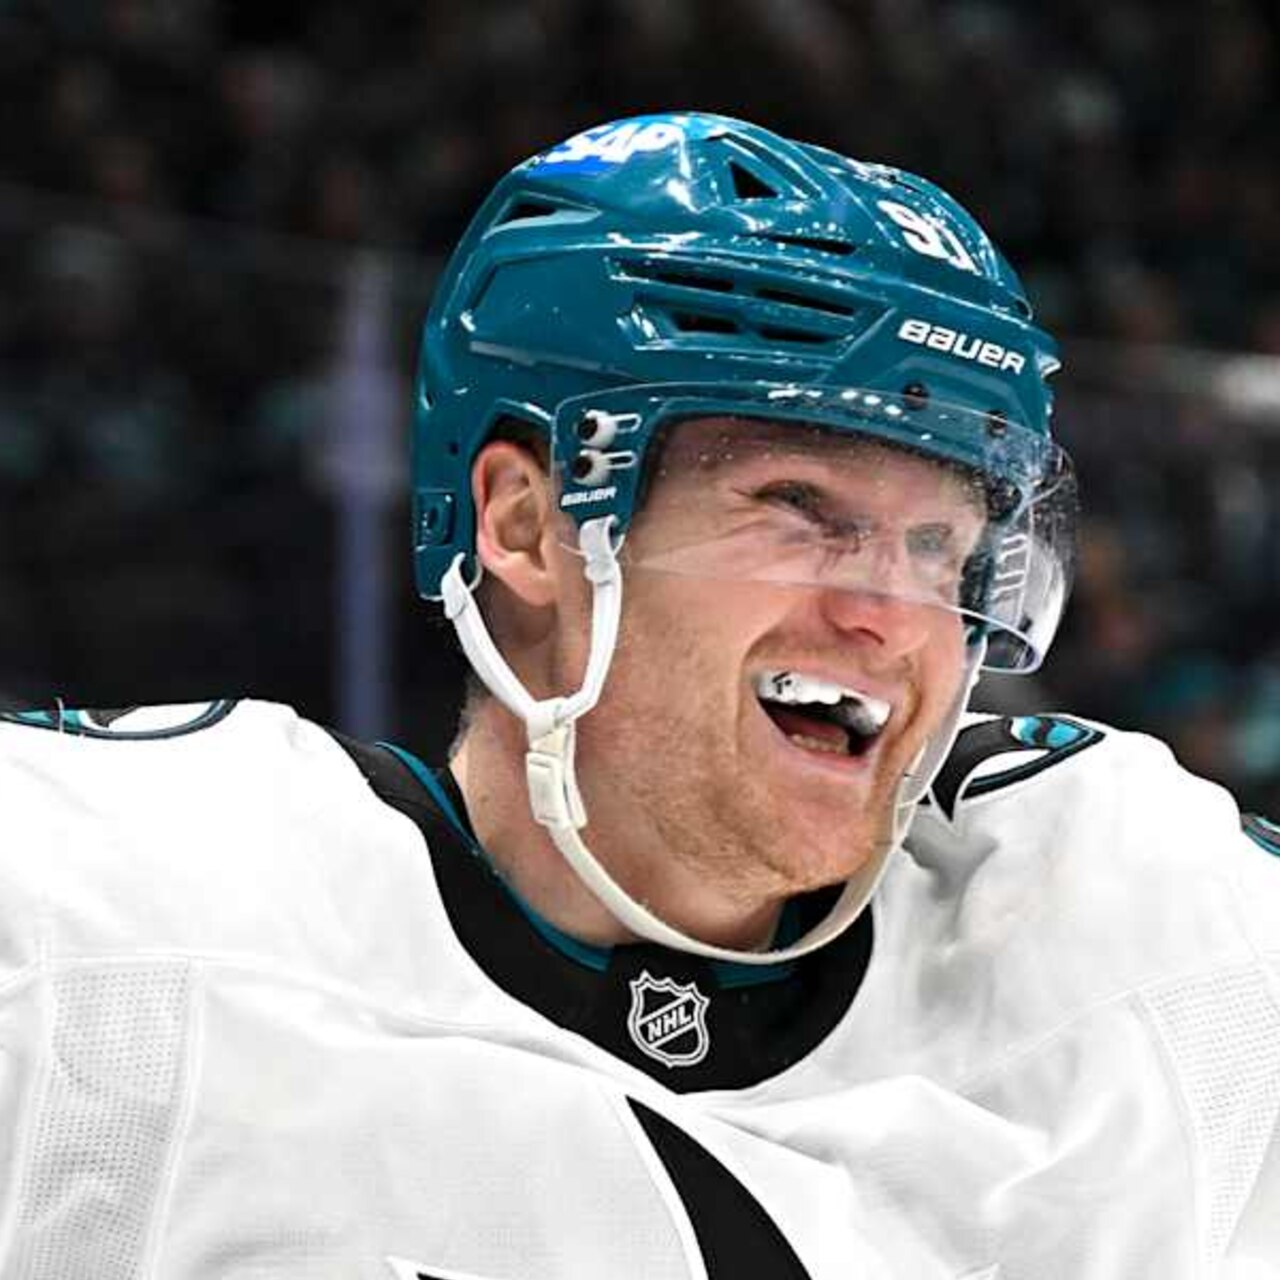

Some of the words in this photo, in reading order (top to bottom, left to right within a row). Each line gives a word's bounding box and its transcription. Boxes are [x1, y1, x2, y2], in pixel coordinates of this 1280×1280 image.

[540, 121, 683, 164] SAP
[876, 200, 982, 276] 91
[897, 318, 1026, 375] BAUER
[646, 1004, 692, 1042] NHL
